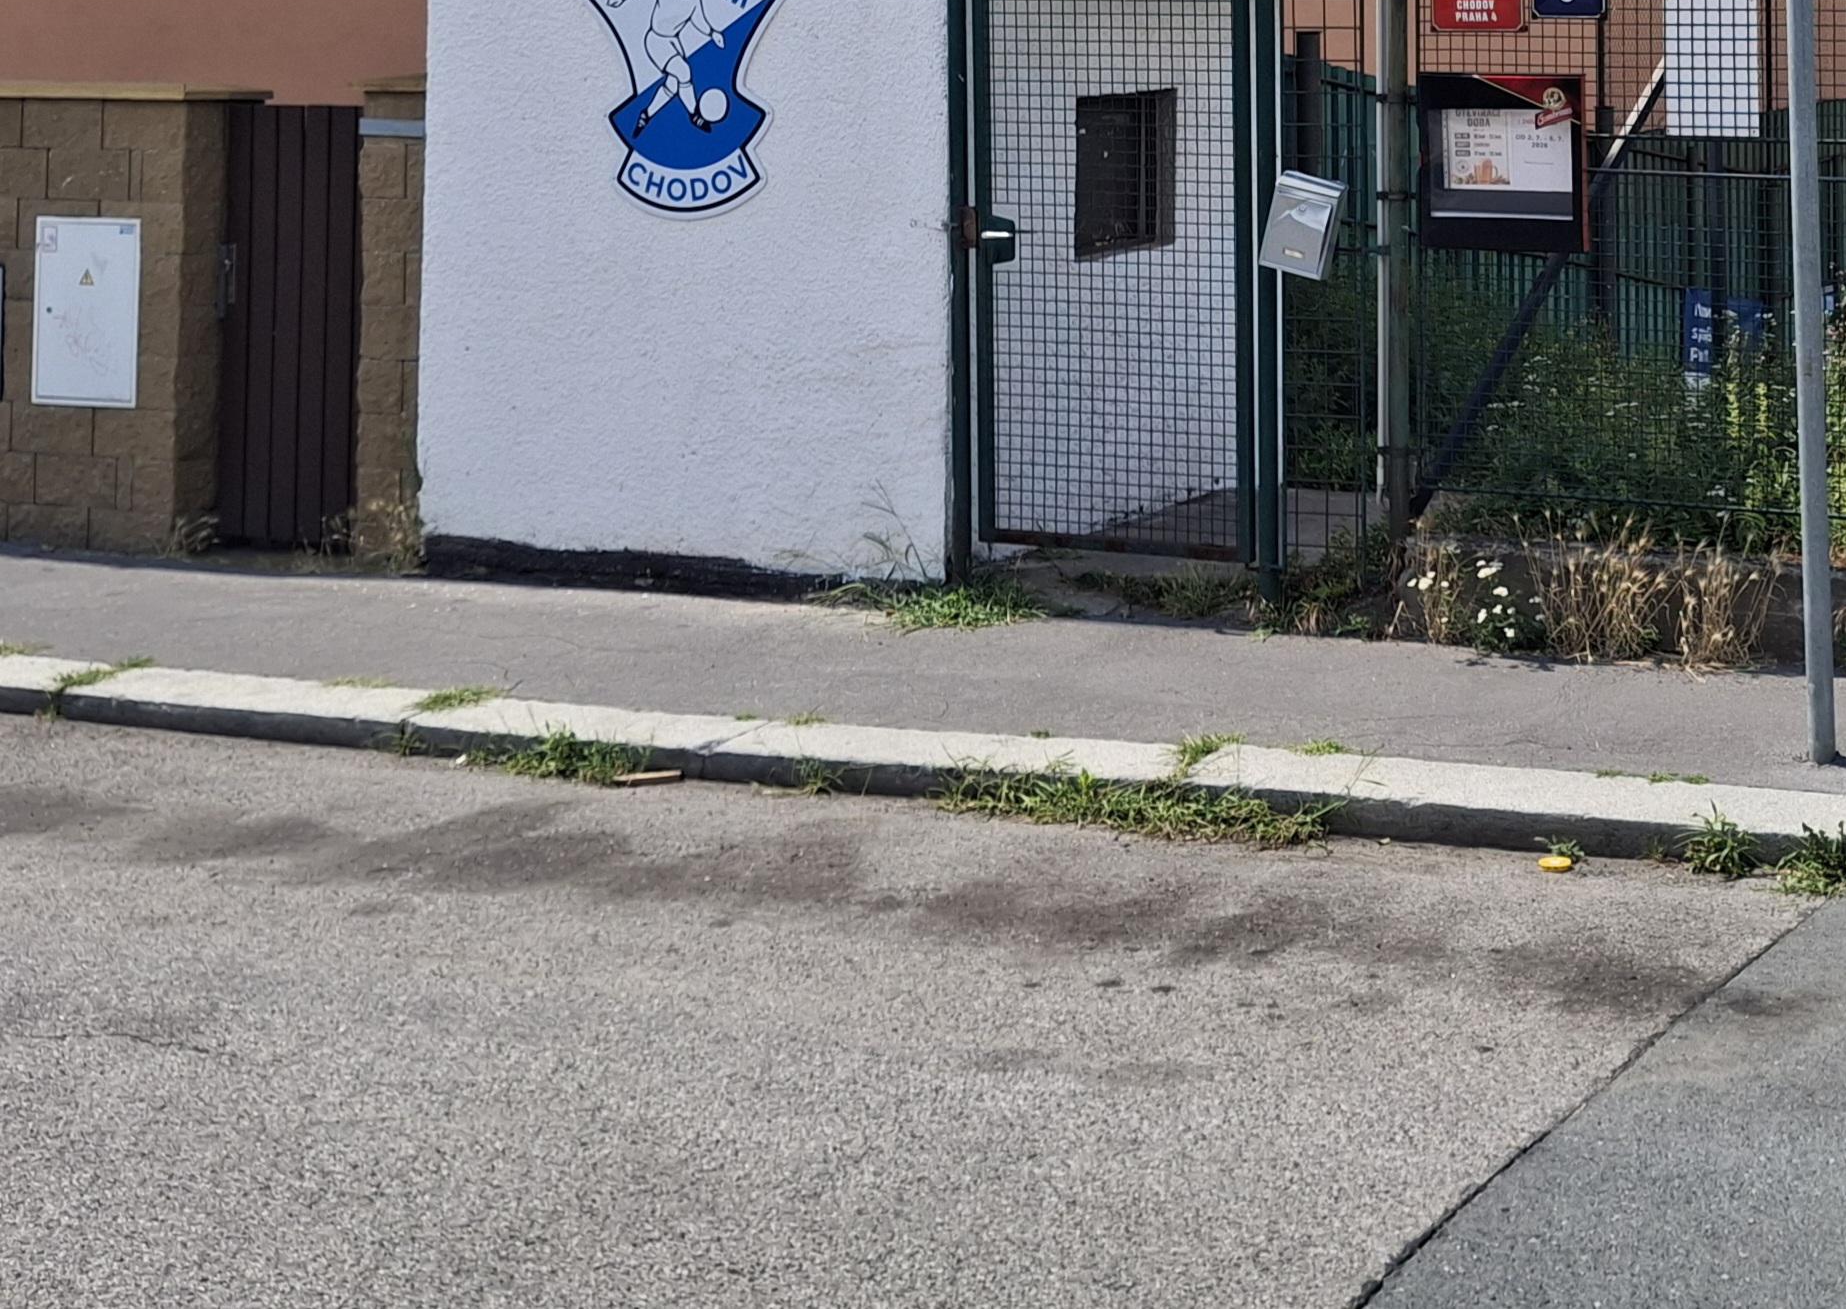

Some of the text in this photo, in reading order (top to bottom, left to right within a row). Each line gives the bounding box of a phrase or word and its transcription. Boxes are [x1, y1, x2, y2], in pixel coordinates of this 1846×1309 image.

[1456, 0, 1495, 11] CHODOV
[1455, 11, 1498, 22] PRAHA 4
[1467, 117, 1491, 128] DOBA
[627, 153, 749, 203] CHODOV
